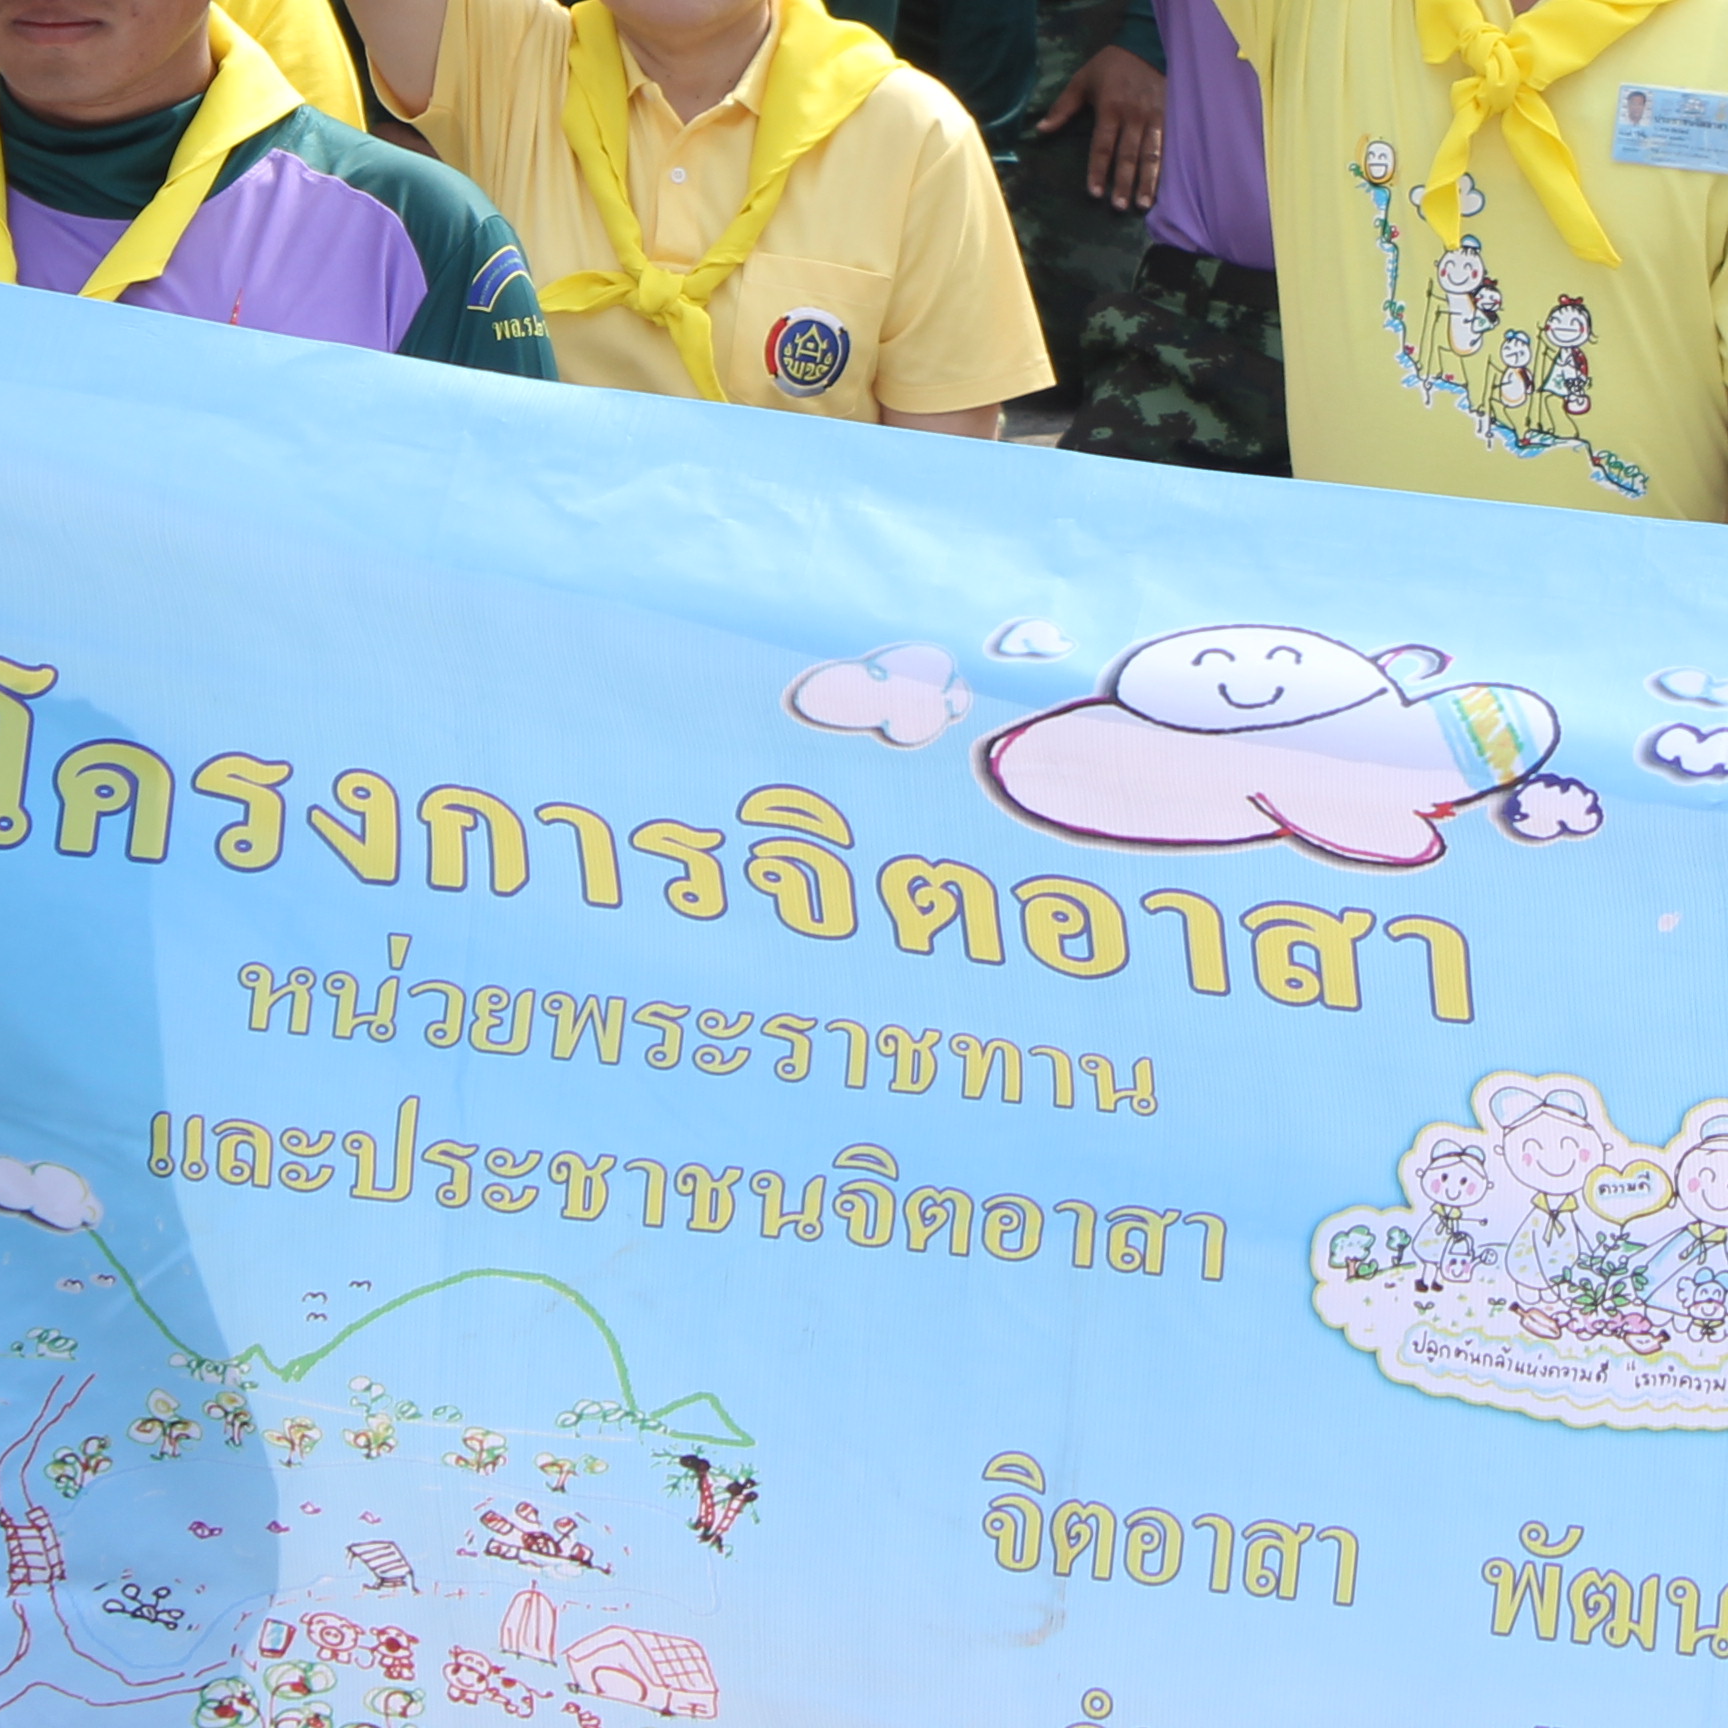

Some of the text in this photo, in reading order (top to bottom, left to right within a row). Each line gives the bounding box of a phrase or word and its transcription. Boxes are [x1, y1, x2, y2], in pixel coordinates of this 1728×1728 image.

[237, 934, 1159, 1118] หน่วยพระราชทาน
[147, 1095, 1228, 1283] และประชาชนจิตอาสา
[981, 1451, 1359, 1607] จิตอาสา
